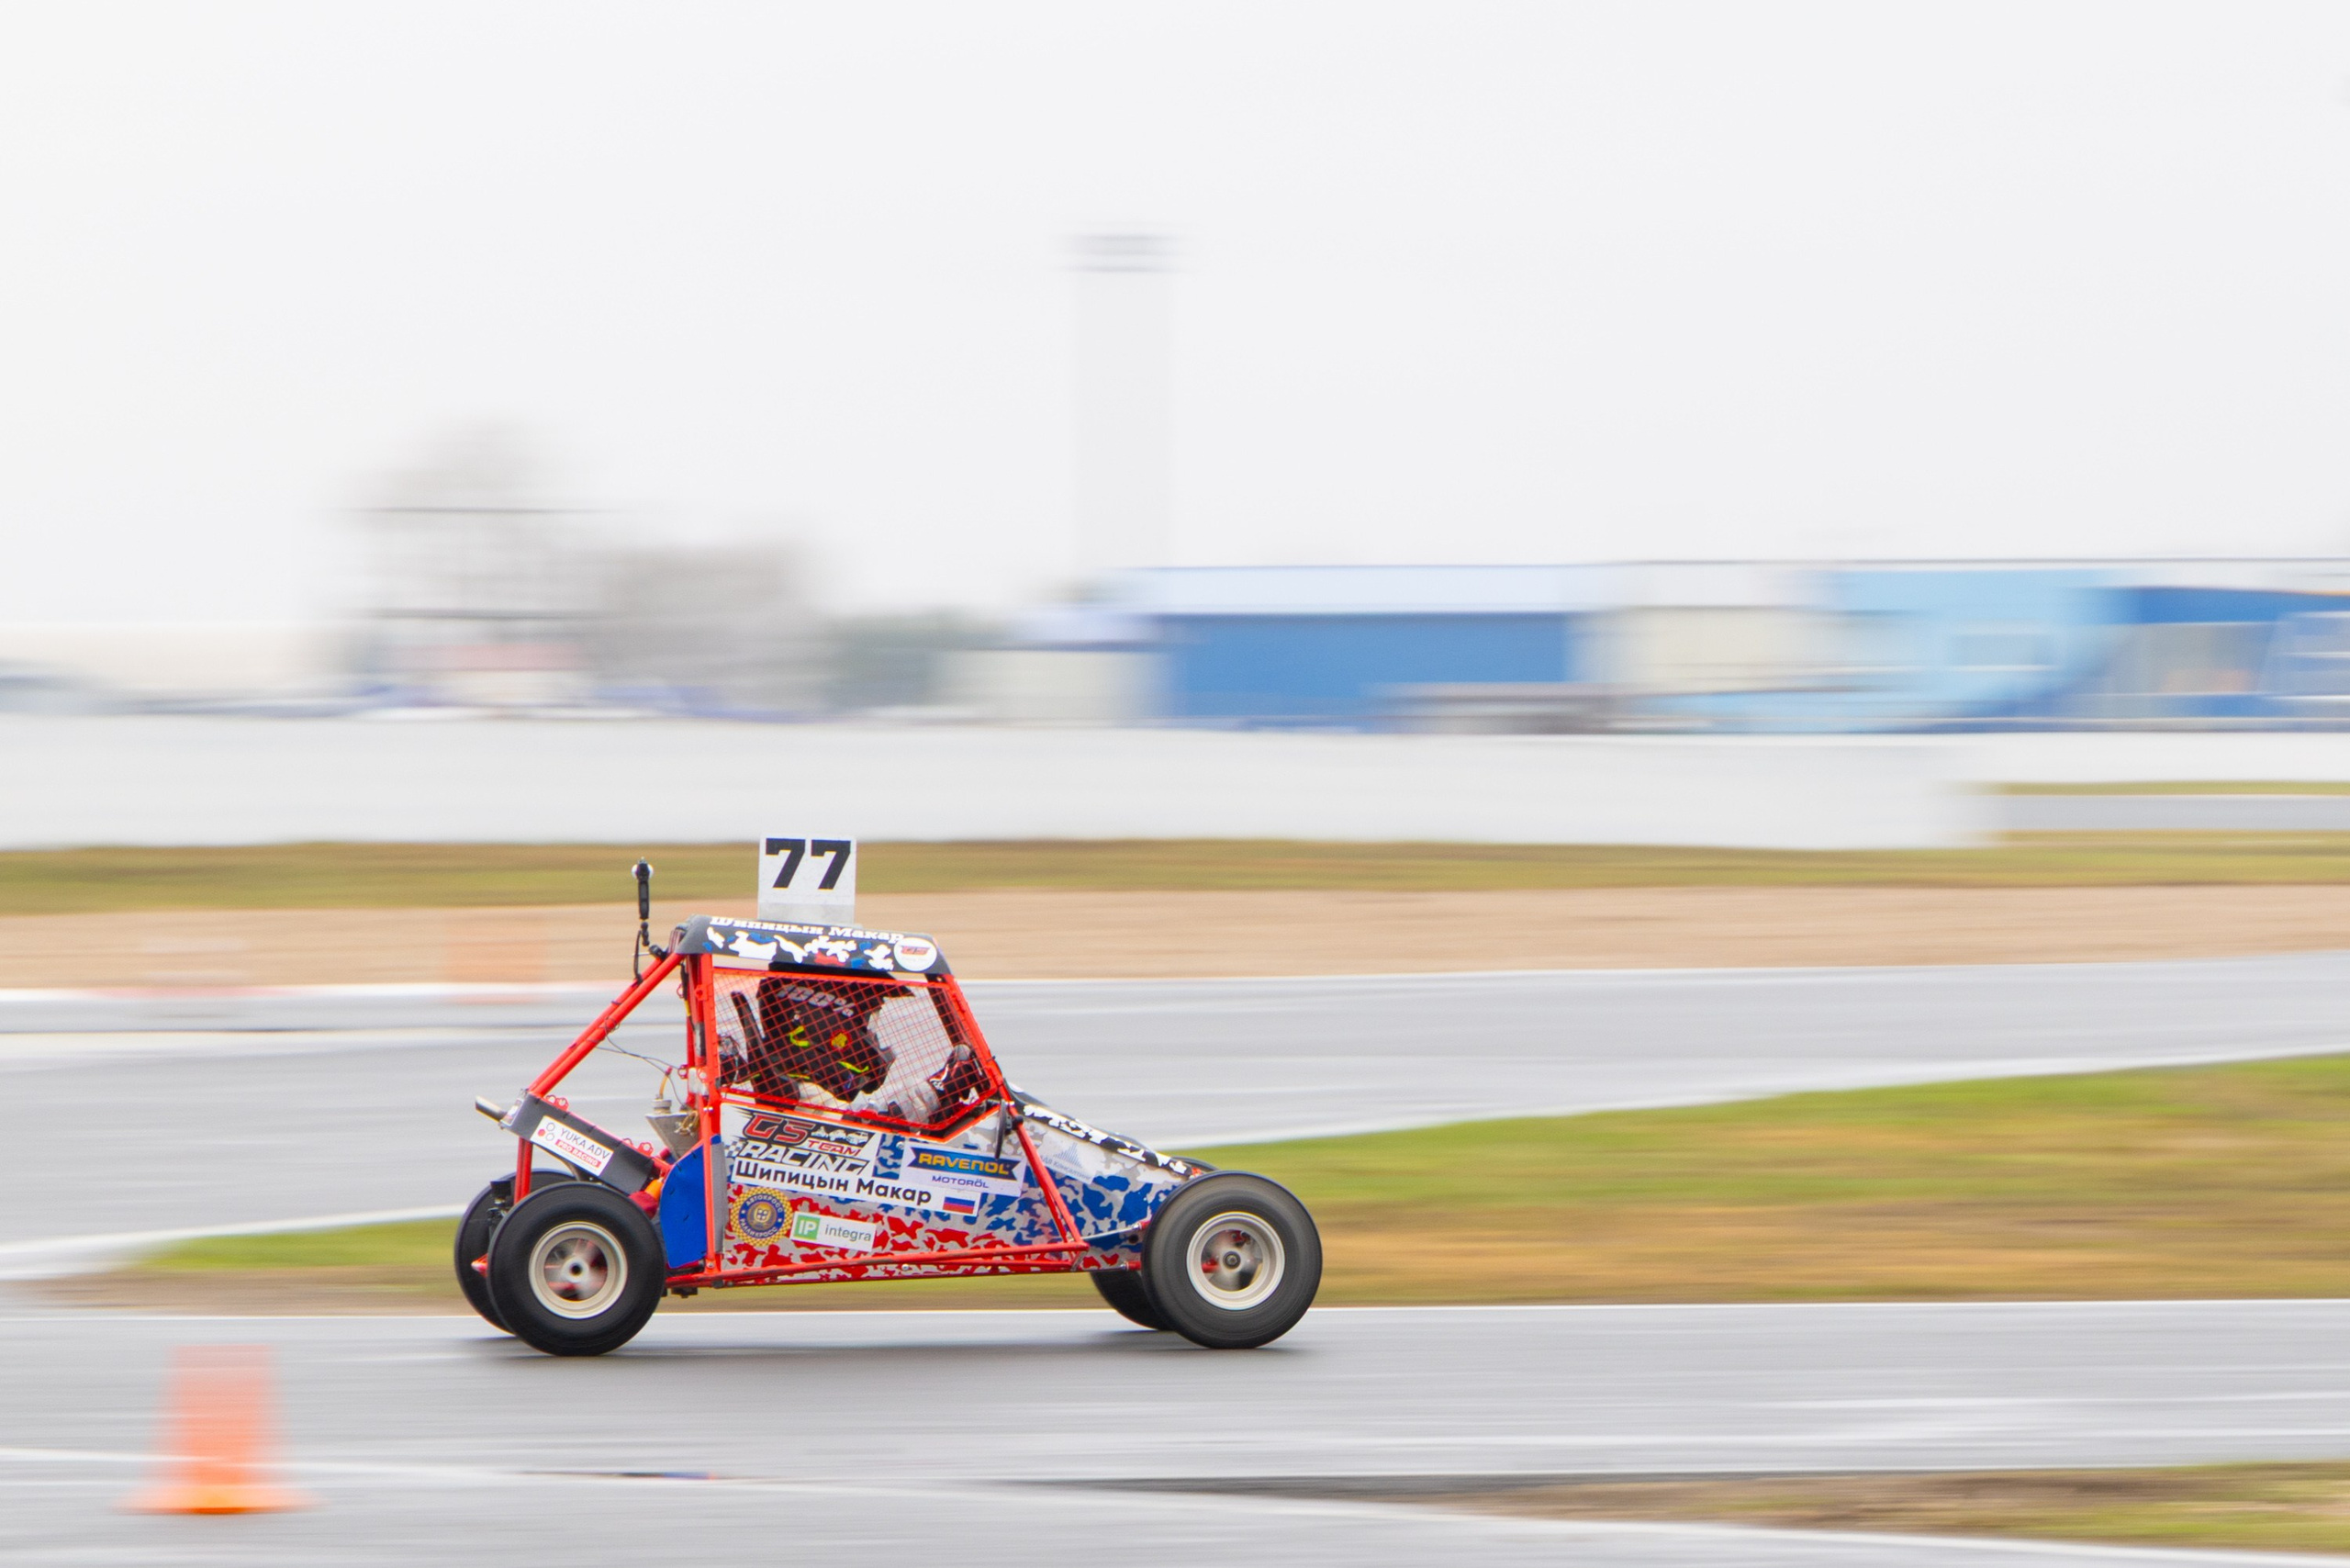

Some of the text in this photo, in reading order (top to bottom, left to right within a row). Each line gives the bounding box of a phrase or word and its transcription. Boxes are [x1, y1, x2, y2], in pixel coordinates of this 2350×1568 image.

[765, 837, 851, 890] 77
[829, 926, 904, 945] Макар
[744, 1113, 816, 1144] GS
[557, 1140, 573, 1152] PRO
[573, 1148, 599, 1165] RACING
[560, 1127, 610, 1159] YUKA ADV
[807, 1139, 862, 1157] TEAM
[737, 1140, 870, 1175] RACING
[918, 1153, 1009, 1175] RAVENOL
[735, 1159, 932, 1205] Шипицын Макар
[932, 1175, 990, 1189] MOTORÖL
[798, 1219, 817, 1235] IP
[825, 1224, 872, 1242] integra
